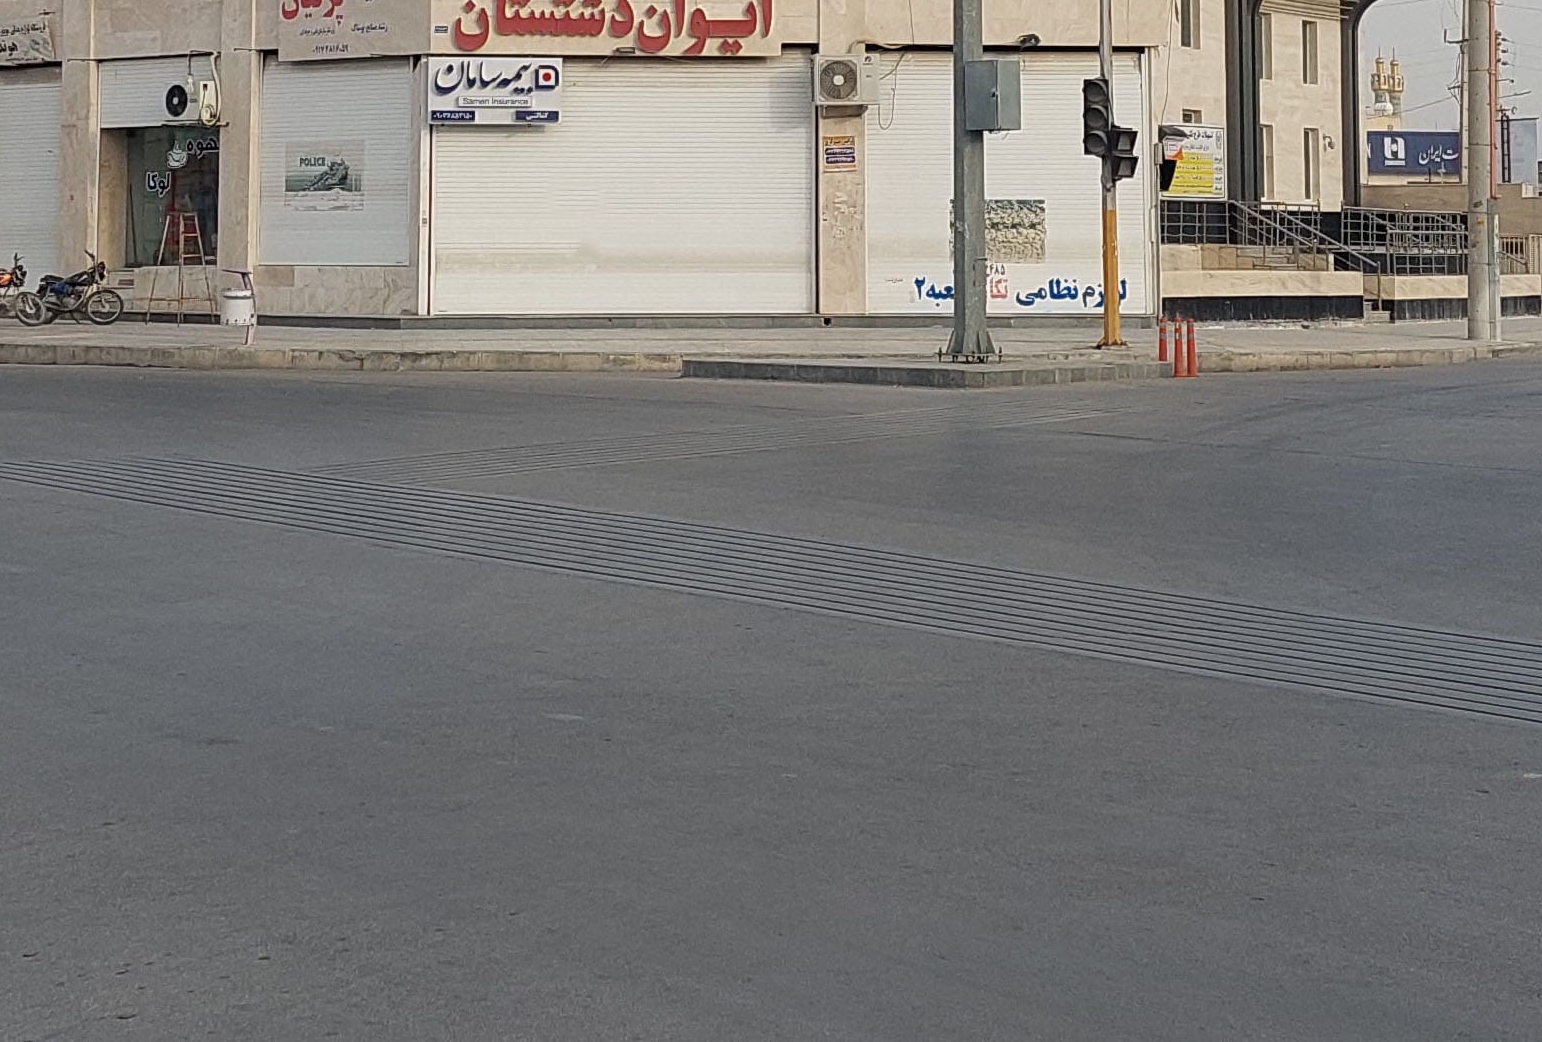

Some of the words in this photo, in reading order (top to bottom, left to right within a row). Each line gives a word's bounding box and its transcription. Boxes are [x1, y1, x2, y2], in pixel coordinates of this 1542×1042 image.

[434, 60, 503, 95] سامان
[462, 97, 490, 105] Saman
[491, 97, 529, 105] Insurance
[1015, 277, 1079, 307] نظامی
